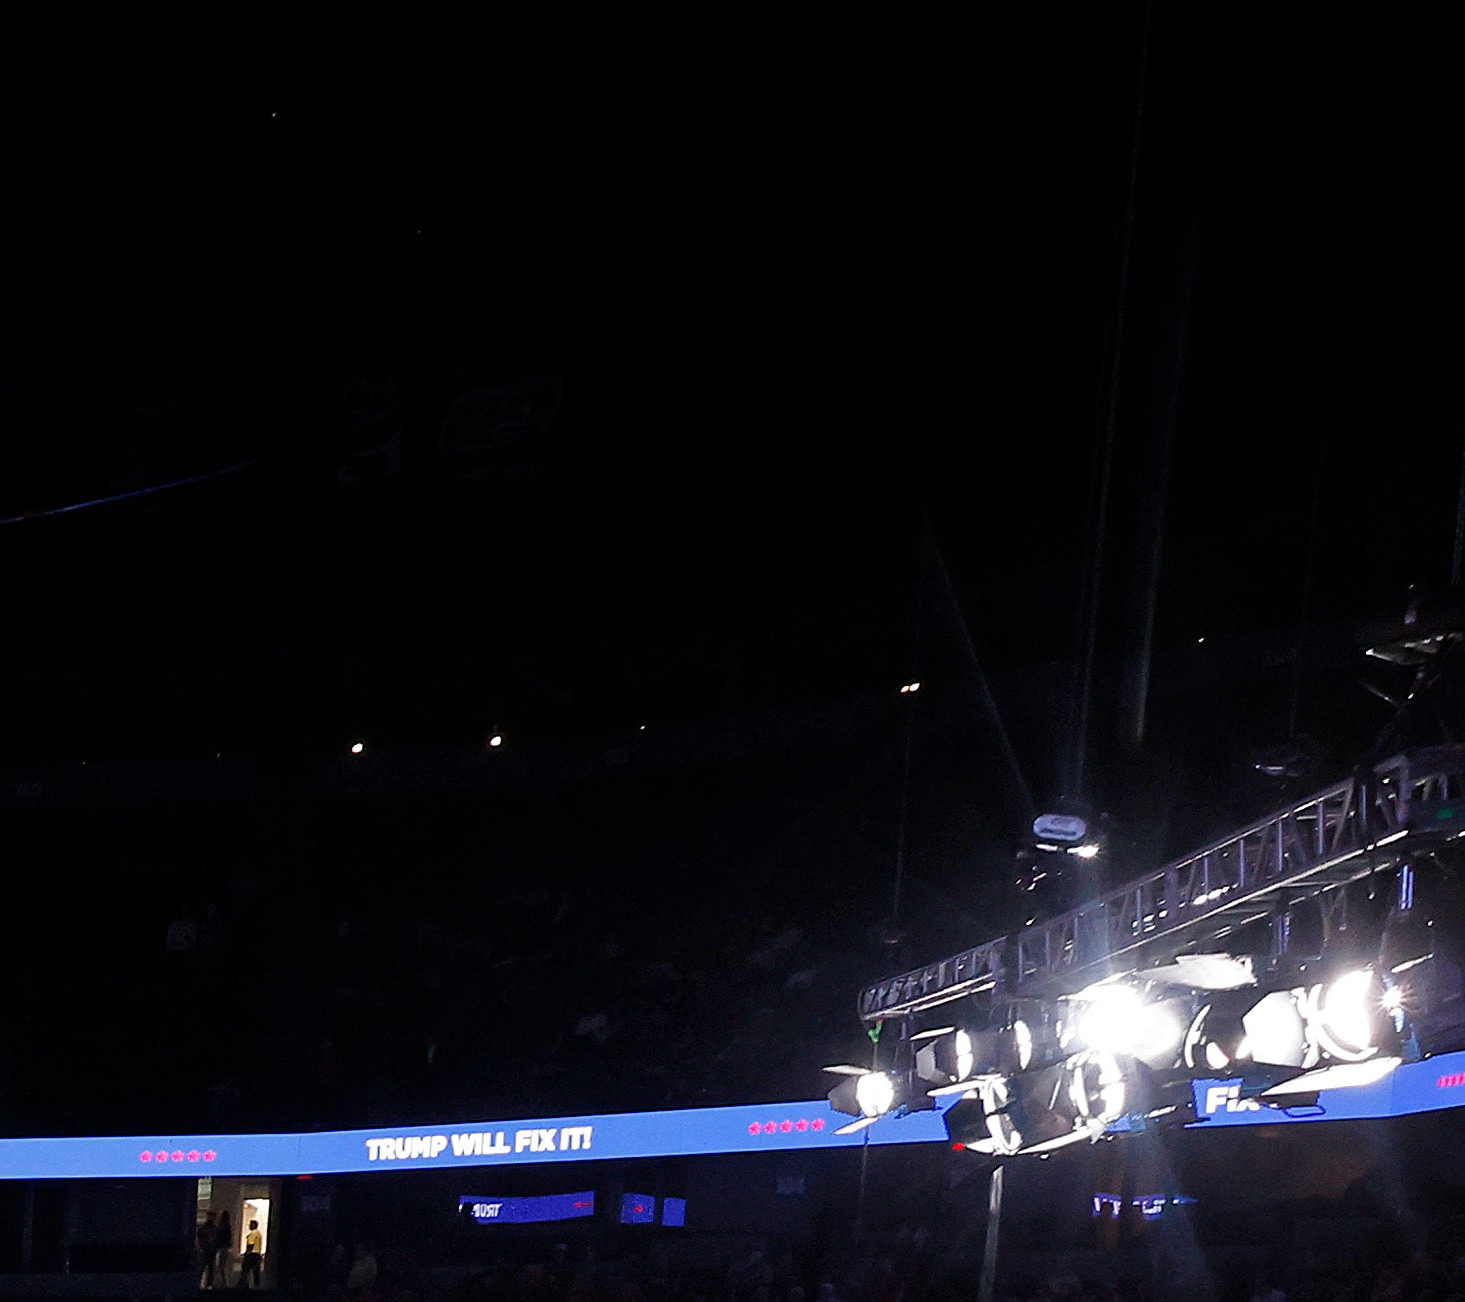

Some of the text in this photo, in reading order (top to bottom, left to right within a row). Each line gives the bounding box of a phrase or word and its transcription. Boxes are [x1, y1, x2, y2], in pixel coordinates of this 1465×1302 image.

[366, 1127, 594, 1161] TRUMP WILL FIX IT!
